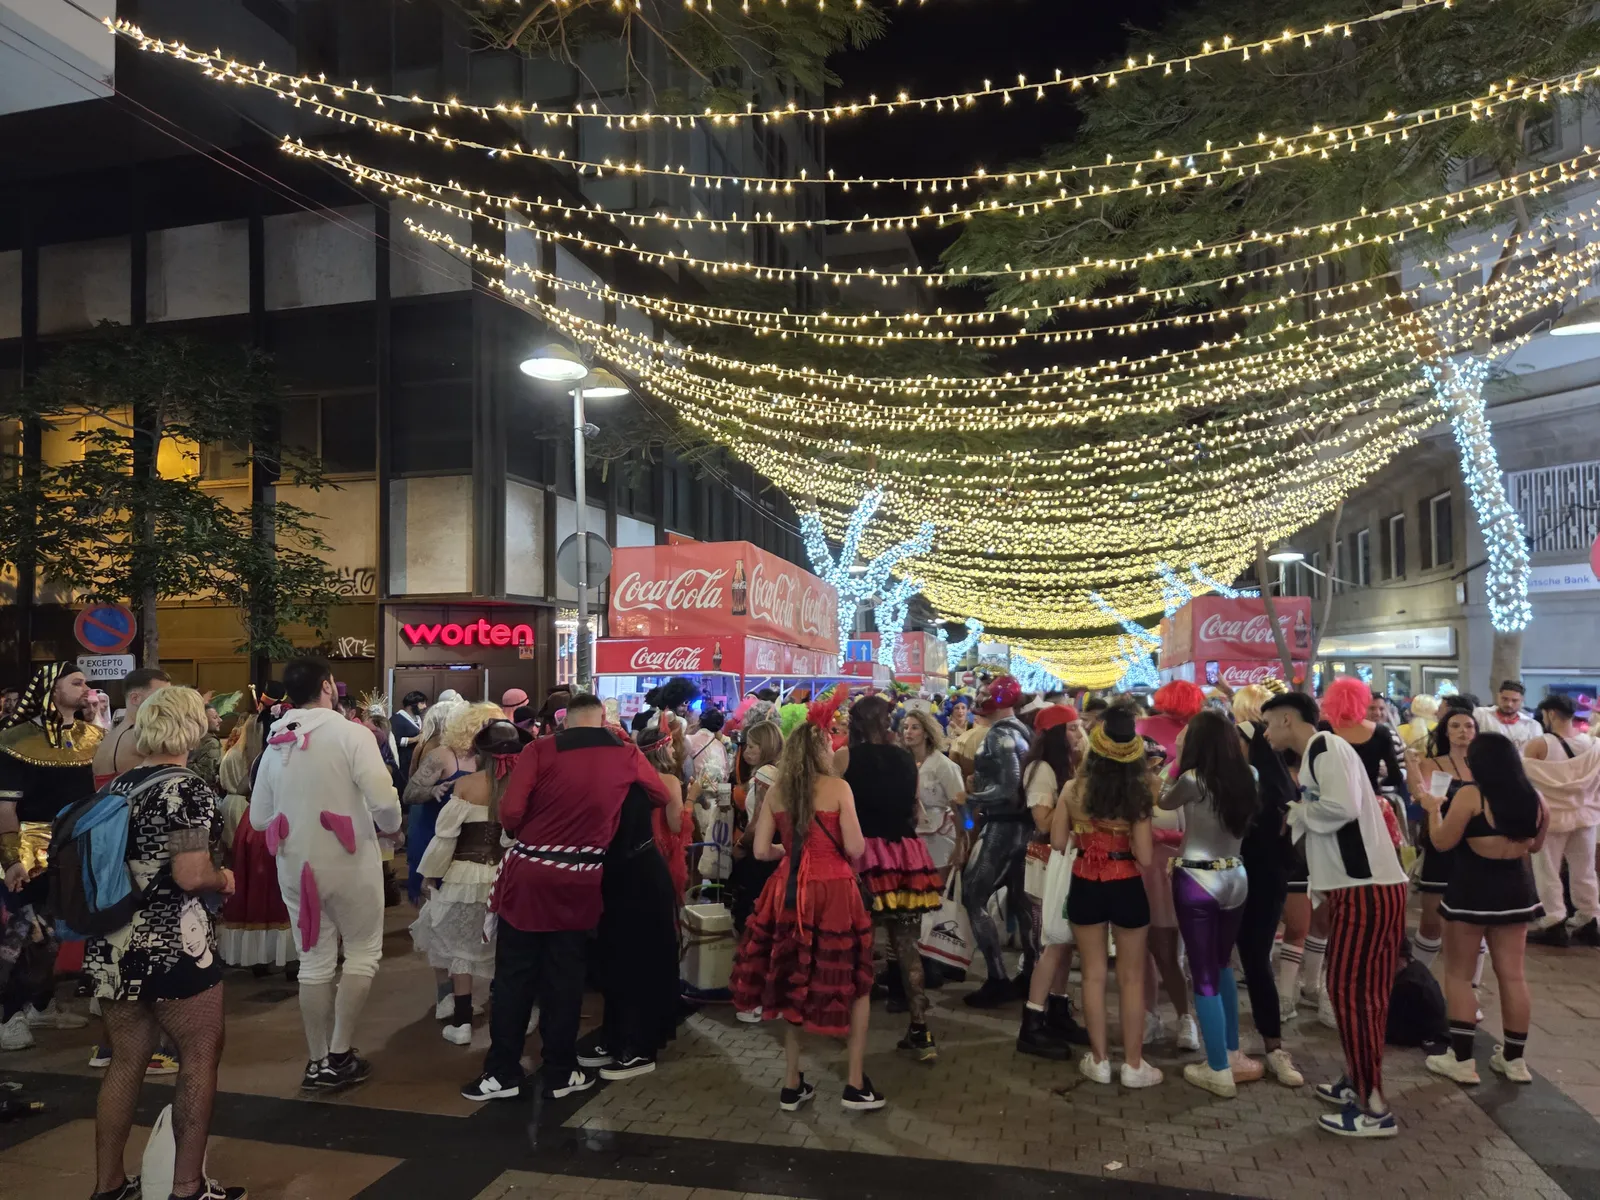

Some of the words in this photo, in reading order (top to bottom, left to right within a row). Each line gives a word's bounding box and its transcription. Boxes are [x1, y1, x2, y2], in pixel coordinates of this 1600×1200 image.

[1564, 575, 1590, 585] Bank
[613, 568, 730, 612] Coca-Cola
[403, 618, 533, 646] worten
[86, 658, 123, 668] EXCEPTO
[630, 646, 705, 670] Coca-Cola
[90, 668, 119, 676] MOTOS
